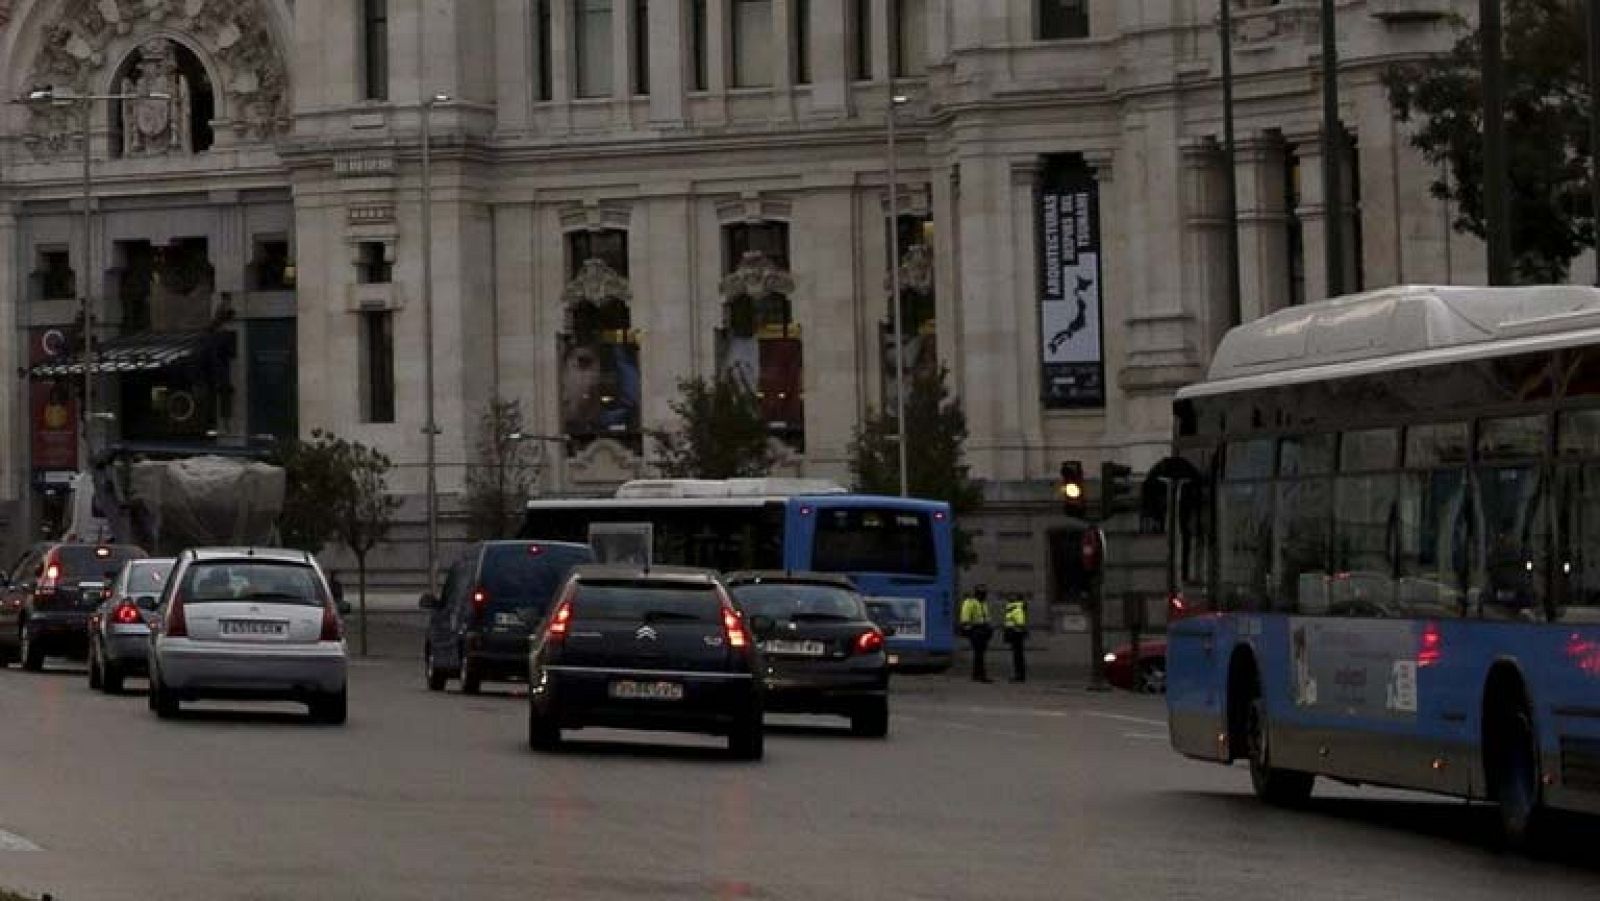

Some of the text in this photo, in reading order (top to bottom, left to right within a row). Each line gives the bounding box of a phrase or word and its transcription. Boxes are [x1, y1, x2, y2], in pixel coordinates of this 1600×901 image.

[1060, 195, 1074, 212] DEL
[1075, 193, 1089, 247] TSUNAMI
[1044, 195, 1060, 295] ARQUITECTURAS
